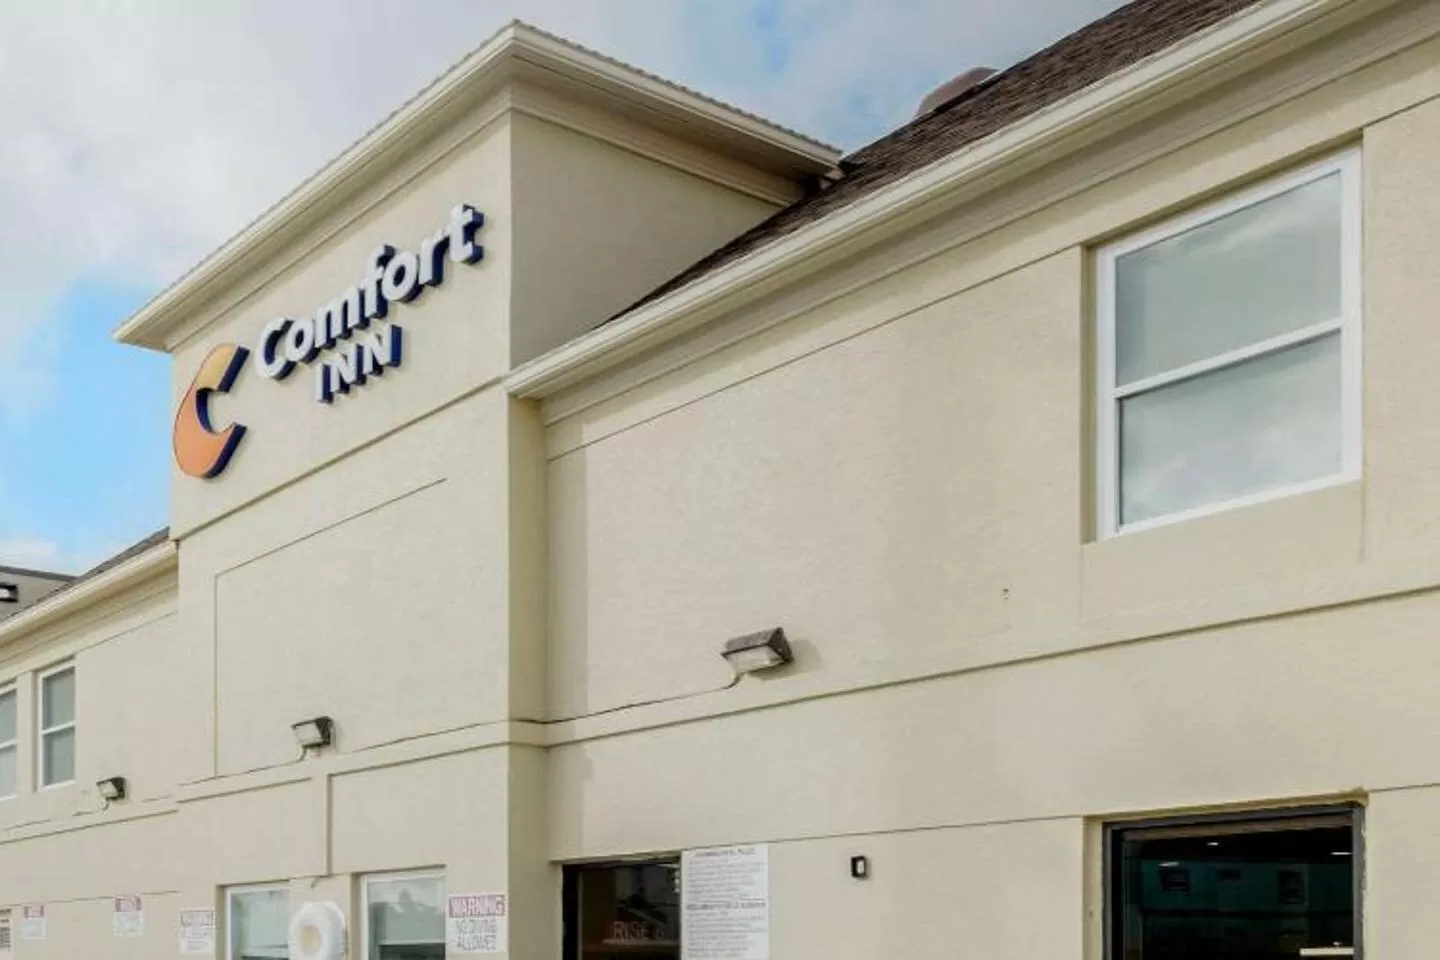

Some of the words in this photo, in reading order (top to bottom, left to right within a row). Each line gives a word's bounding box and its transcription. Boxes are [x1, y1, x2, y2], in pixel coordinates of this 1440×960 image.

[256, 203, 484, 380] Comfort
[317, 324, 402, 404] INN
[451, 897, 504, 916] WARNING
